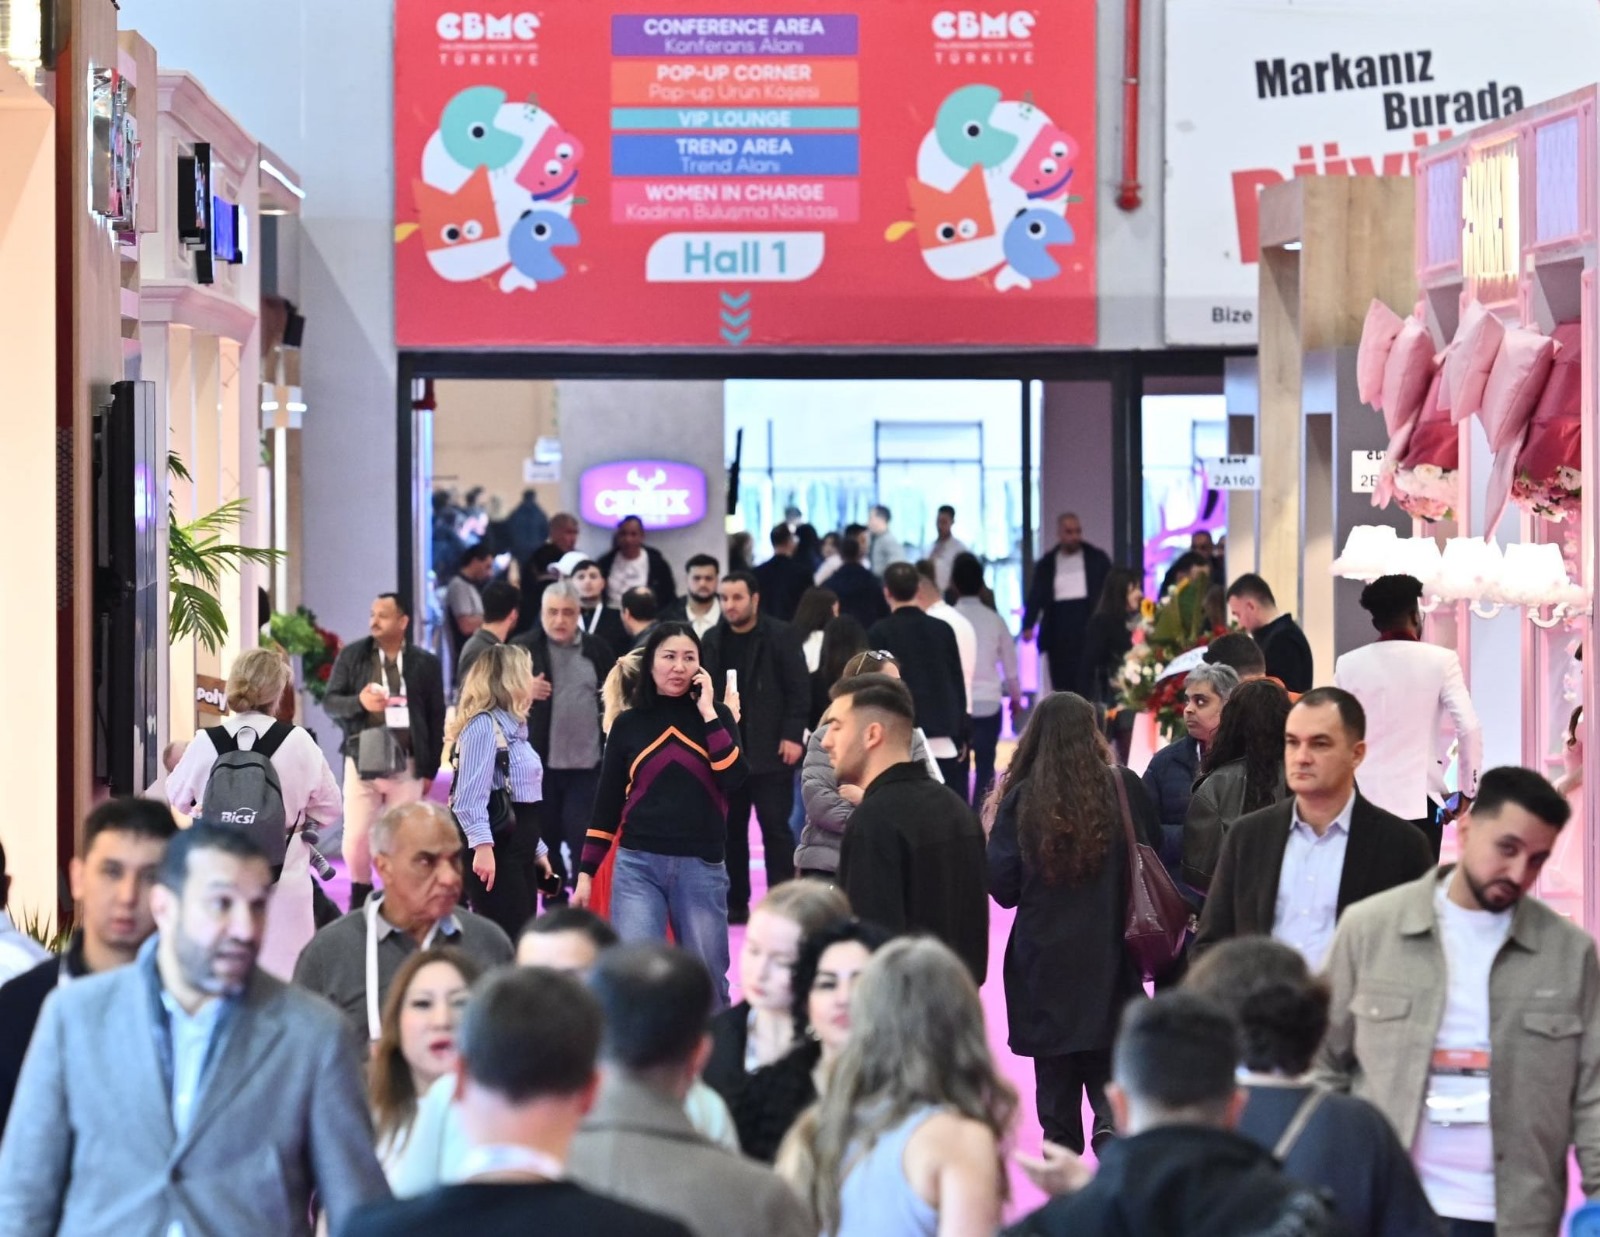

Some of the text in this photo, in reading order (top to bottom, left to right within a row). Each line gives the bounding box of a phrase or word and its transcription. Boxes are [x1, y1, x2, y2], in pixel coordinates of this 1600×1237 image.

[436, 11, 541, 40] CBME
[644, 18, 824, 35] CONFERENCE AREA
[931, 10, 1036, 39] CBME
[664, 38, 755, 54] Konferans
[657, 64, 812, 81] POP-UP CORNER
[1255, 49, 1434, 99] Markanız
[649, 83, 714, 103] Pop-up
[1383, 81, 1523, 130] Burada
[678, 111, 792, 128] VIP LOUNGE
[676, 138, 794, 155] TREND AREA
[681, 157, 733, 173] Trend
[646, 184, 824, 200] WOMEN IN CHARGE
[684, 241, 786, 274] Hall 1
[1212, 306, 1253, 324] Bize
[1214, 474, 1255, 487] 2A160
[221, 811, 258, 824] Bicsi
